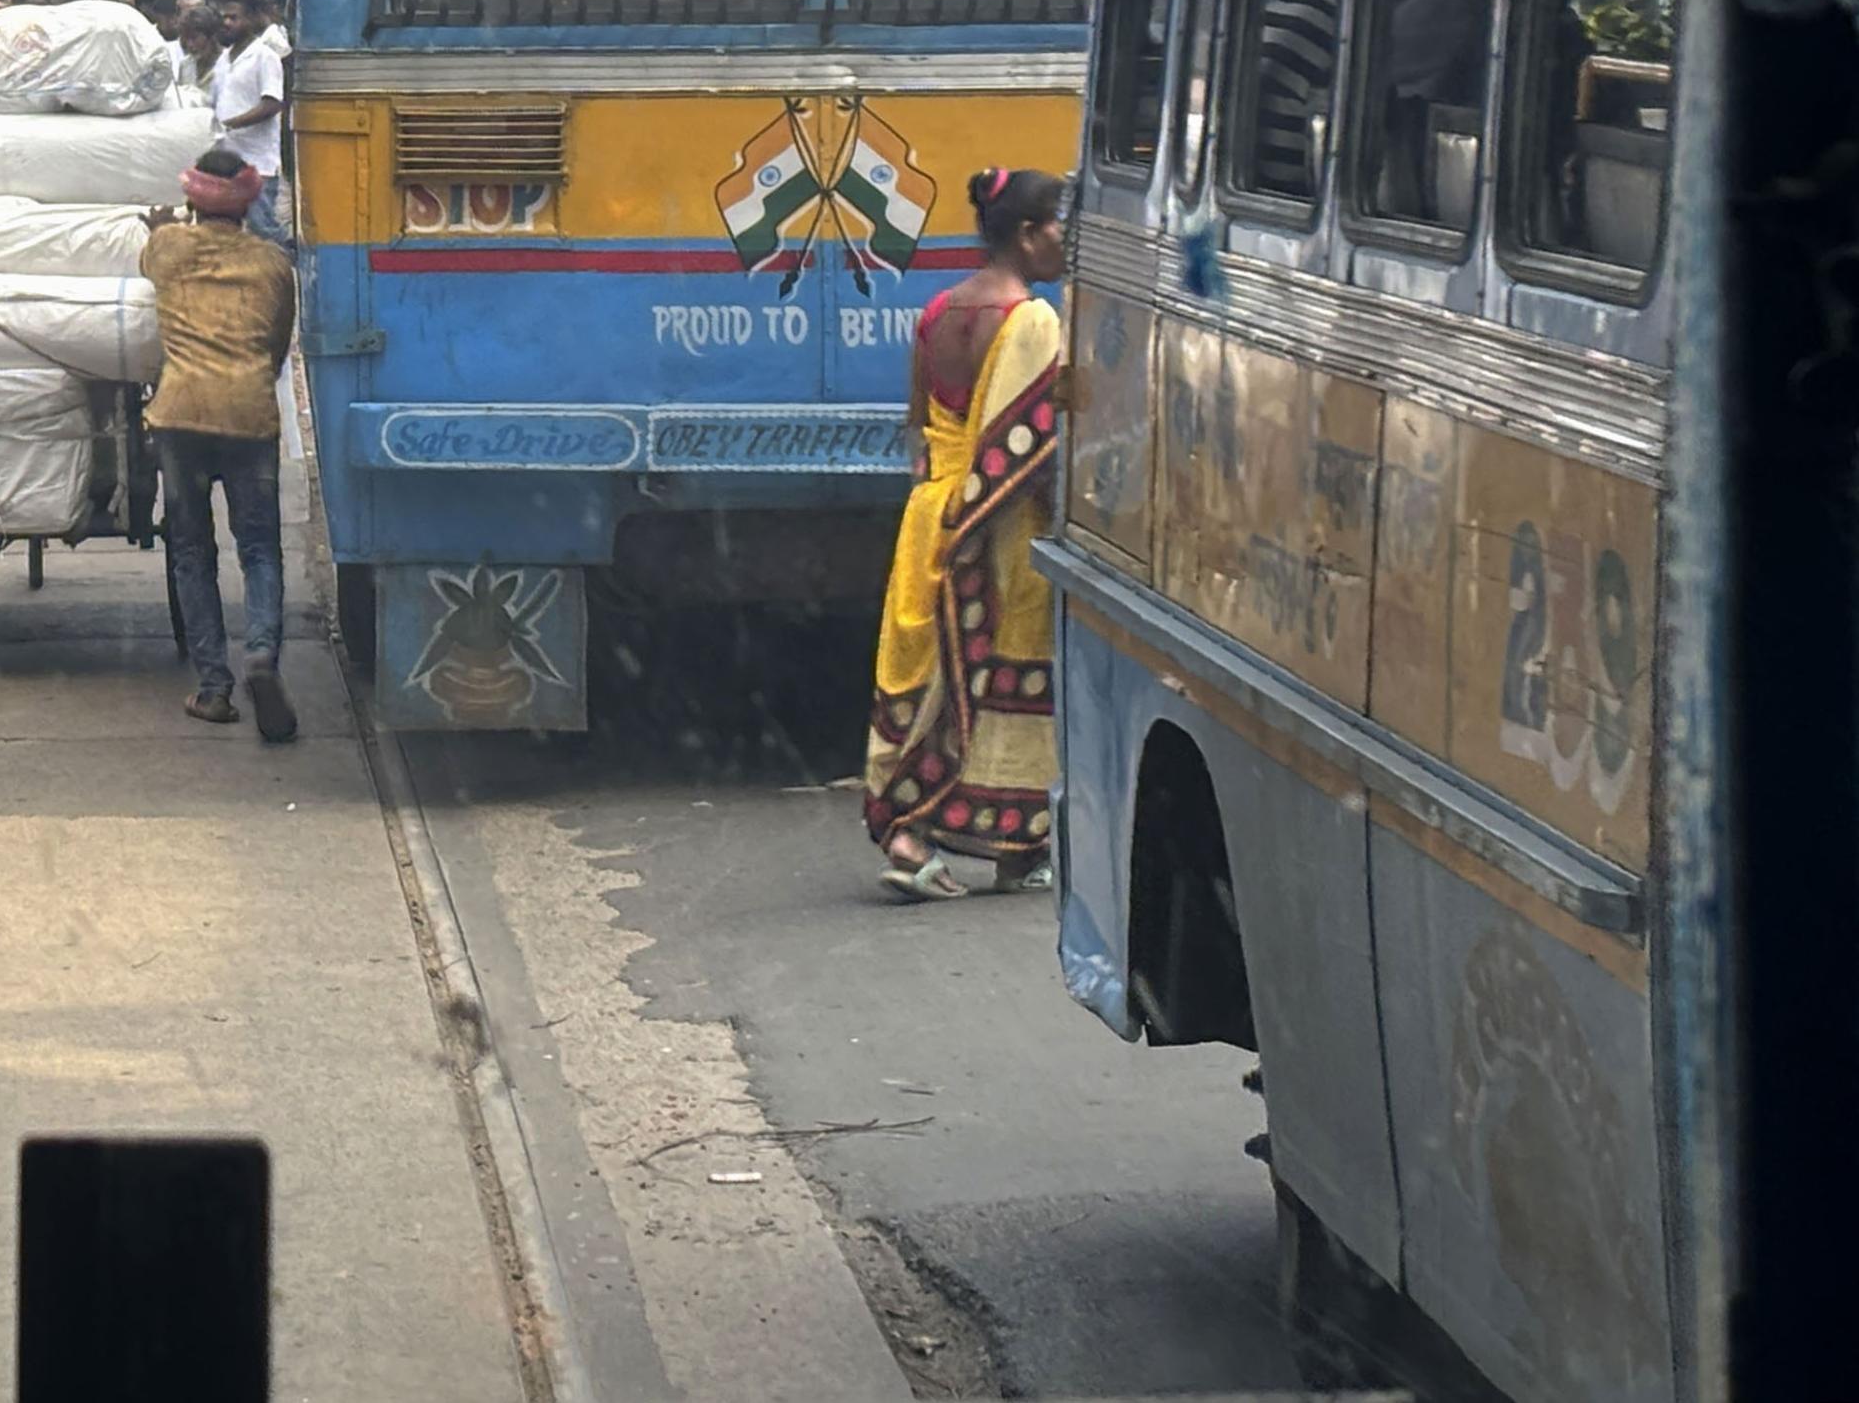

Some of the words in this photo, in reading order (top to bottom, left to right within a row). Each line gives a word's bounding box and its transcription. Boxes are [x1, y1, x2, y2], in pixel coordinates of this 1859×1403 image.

[652, 305, 754, 357] PROUD
[762, 306, 809, 346] TO
[839, 308, 877, 348] BE
[395, 419, 473, 458] Safe
[476, 422, 630, 458] Drive
[656, 424, 744, 459] OBEY
[745, 423, 885, 458] TRAFFIC
